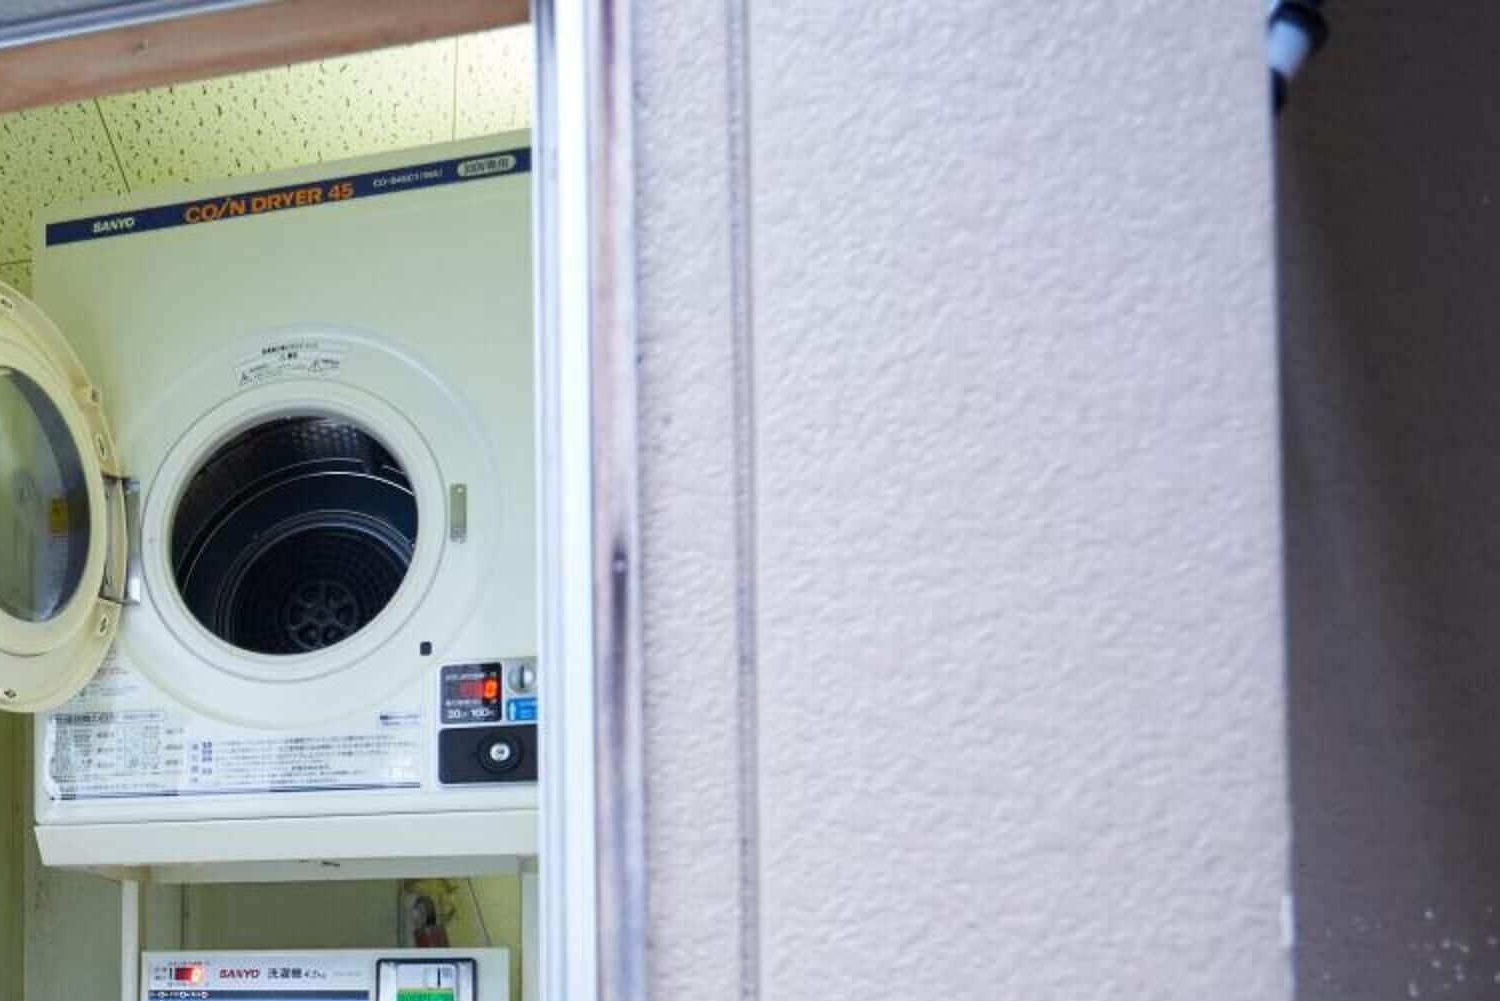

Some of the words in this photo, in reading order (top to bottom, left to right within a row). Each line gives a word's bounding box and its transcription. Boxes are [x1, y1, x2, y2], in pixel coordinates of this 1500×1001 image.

[251, 186, 324, 213] DRYER
[327, 182, 355, 202] 45
[92, 216, 136, 234] SANYO
[219, 968, 261, 980] SANYO
